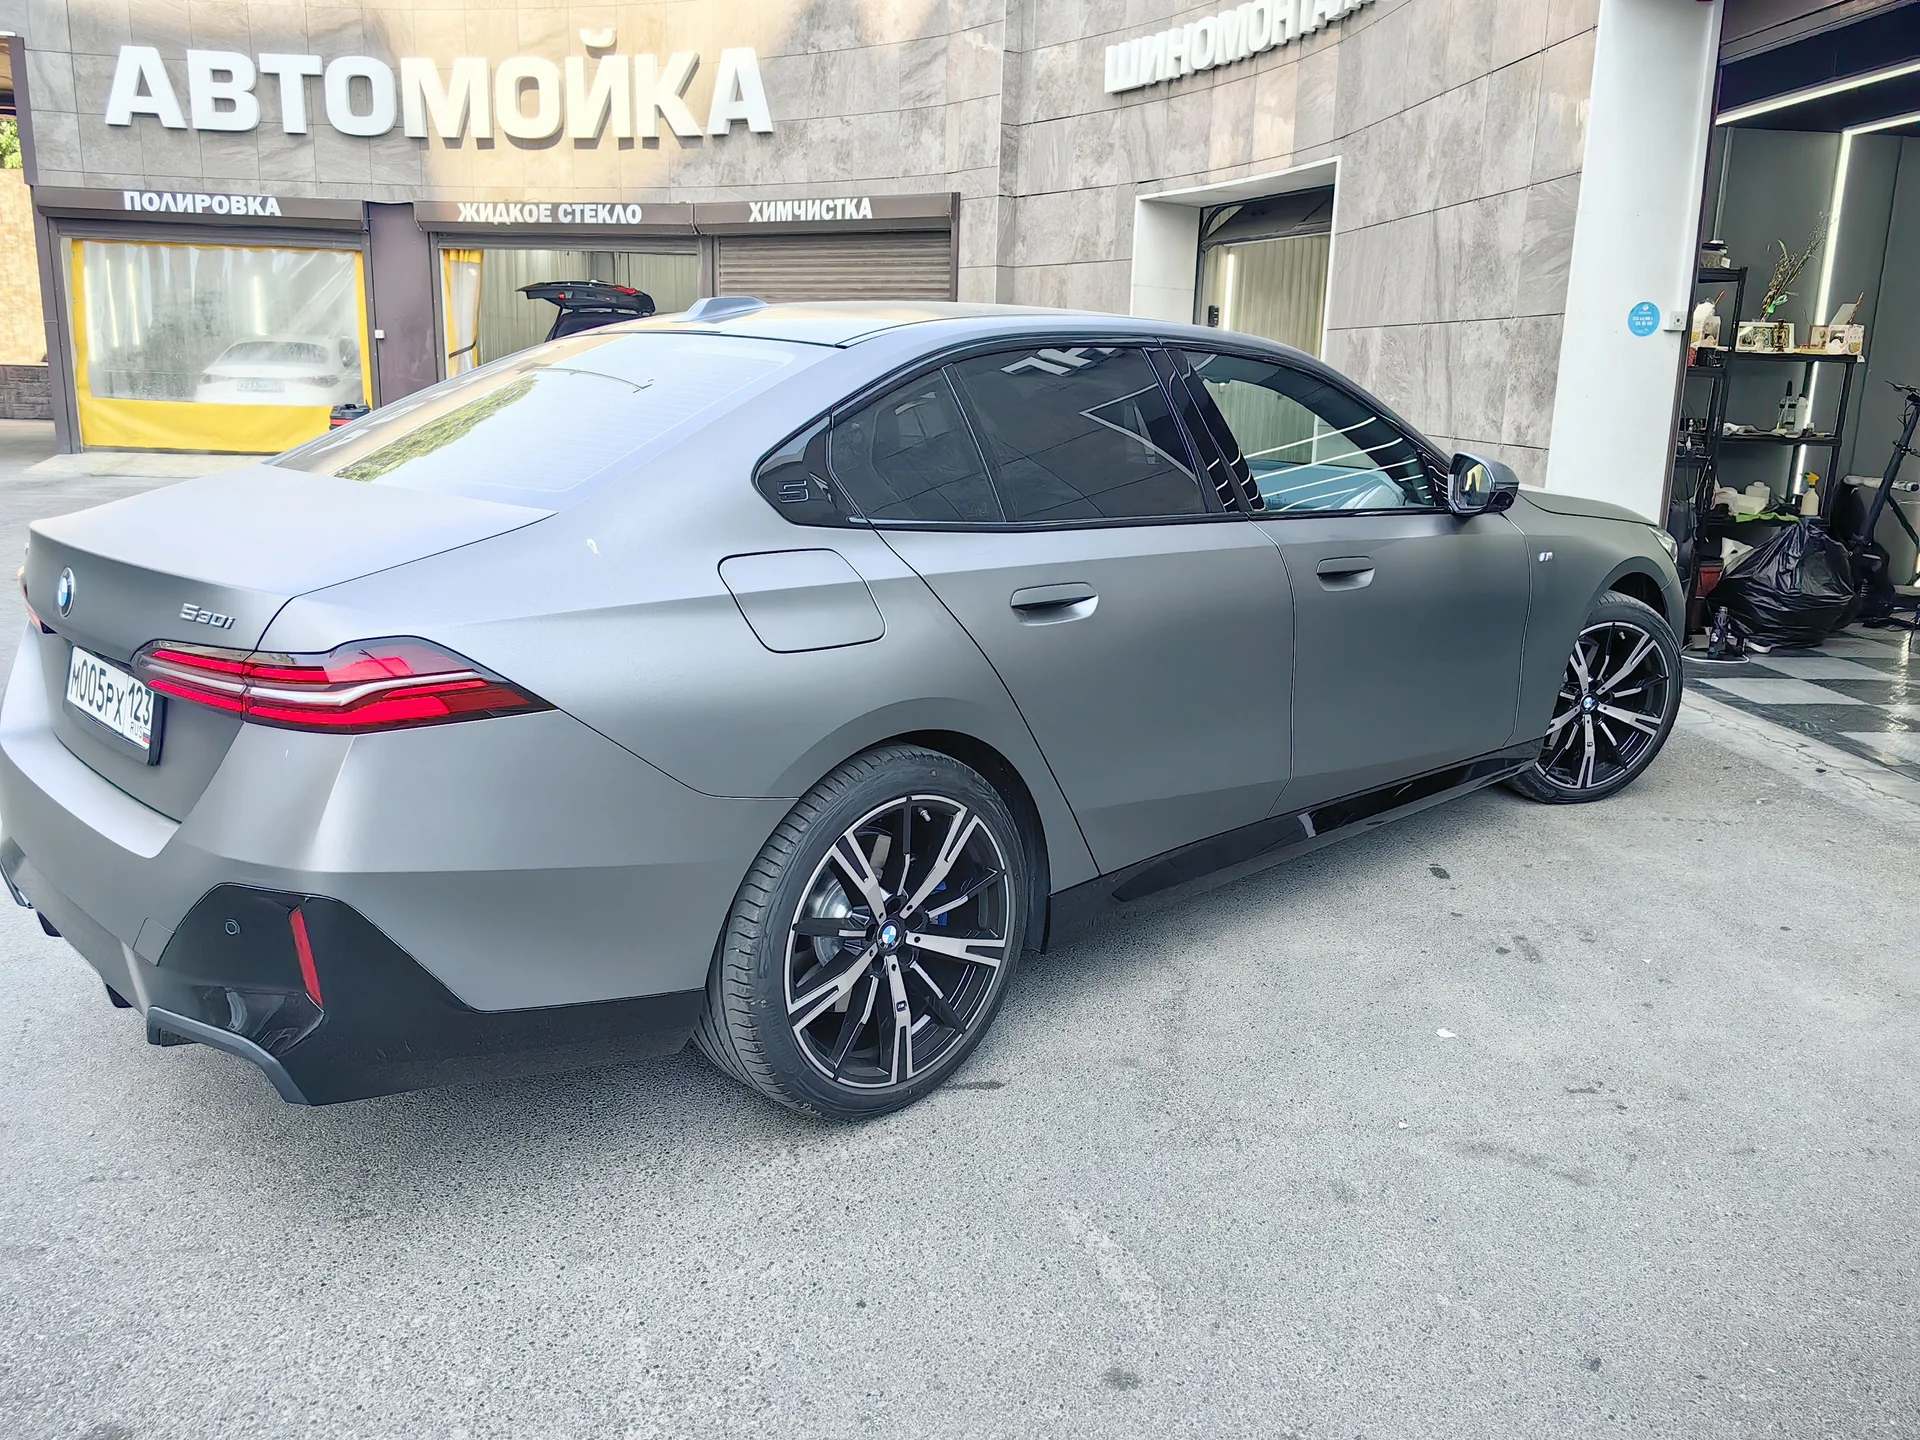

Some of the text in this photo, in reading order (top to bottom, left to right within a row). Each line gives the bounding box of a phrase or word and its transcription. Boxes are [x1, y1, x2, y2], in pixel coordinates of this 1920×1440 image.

[1104, 0, 1374, 93] ШИНОМОНТА
[104, 27, 774, 140] АВТОМОЙКА
[123, 190, 282, 217] ПОЛИРОВКА
[457, 202, 642, 225] ЖИДКОЕ СТЕКЛО
[748, 197, 873, 223] ХИМЧИСТКА
[179, 602, 235, 630] 530i
[128, 682, 153, 726] 123
[129, 721, 144, 739] RUS
